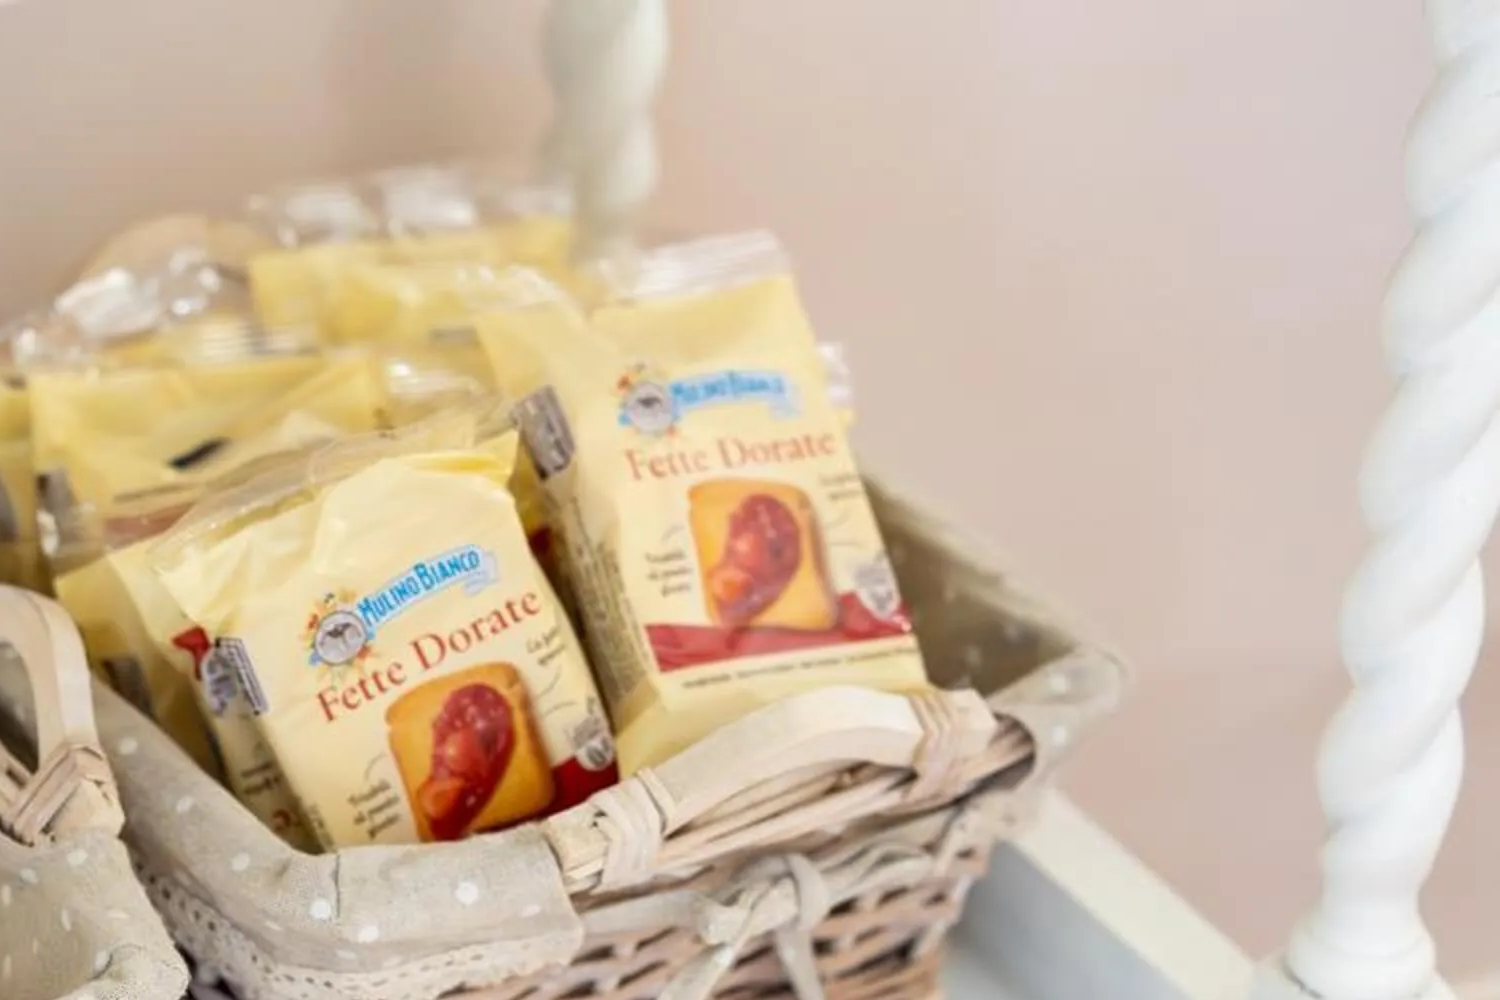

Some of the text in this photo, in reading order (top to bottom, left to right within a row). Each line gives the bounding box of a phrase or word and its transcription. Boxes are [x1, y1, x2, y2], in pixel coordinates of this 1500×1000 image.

[625, 433, 835, 480] Fette Dorate
[317, 661, 407, 724] Fette
[409, 592, 540, 670] Dorate
